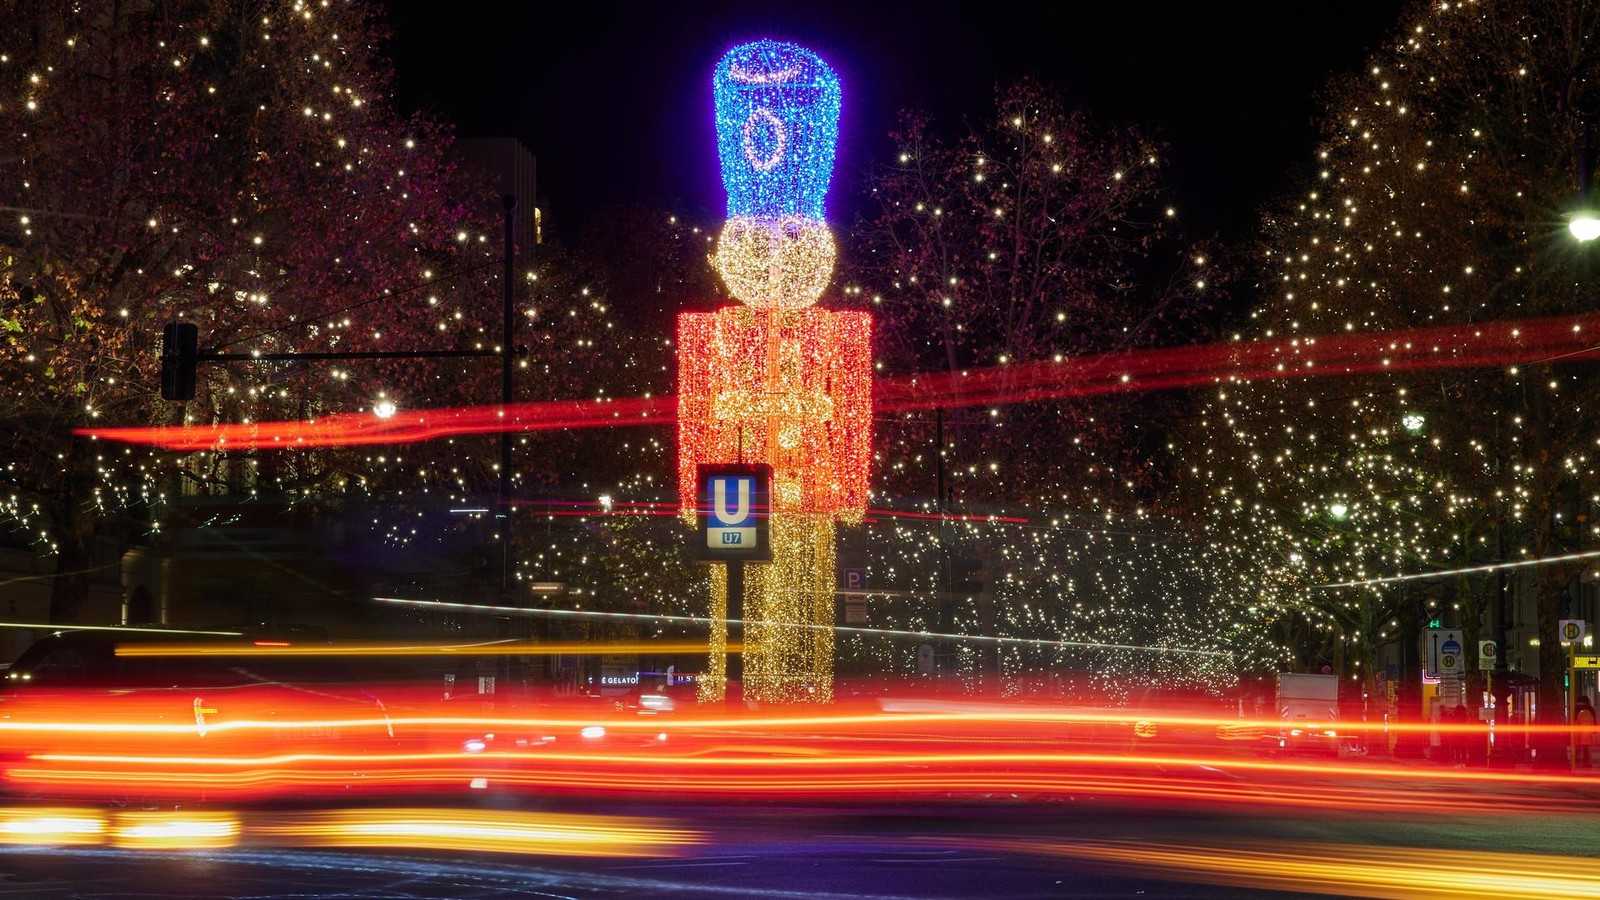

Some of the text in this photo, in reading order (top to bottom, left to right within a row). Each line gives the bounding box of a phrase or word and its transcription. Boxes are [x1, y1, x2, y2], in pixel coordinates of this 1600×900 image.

[714, 479, 750, 525] U
[724, 533, 740, 543] U7
[848, 572, 861, 589] P
